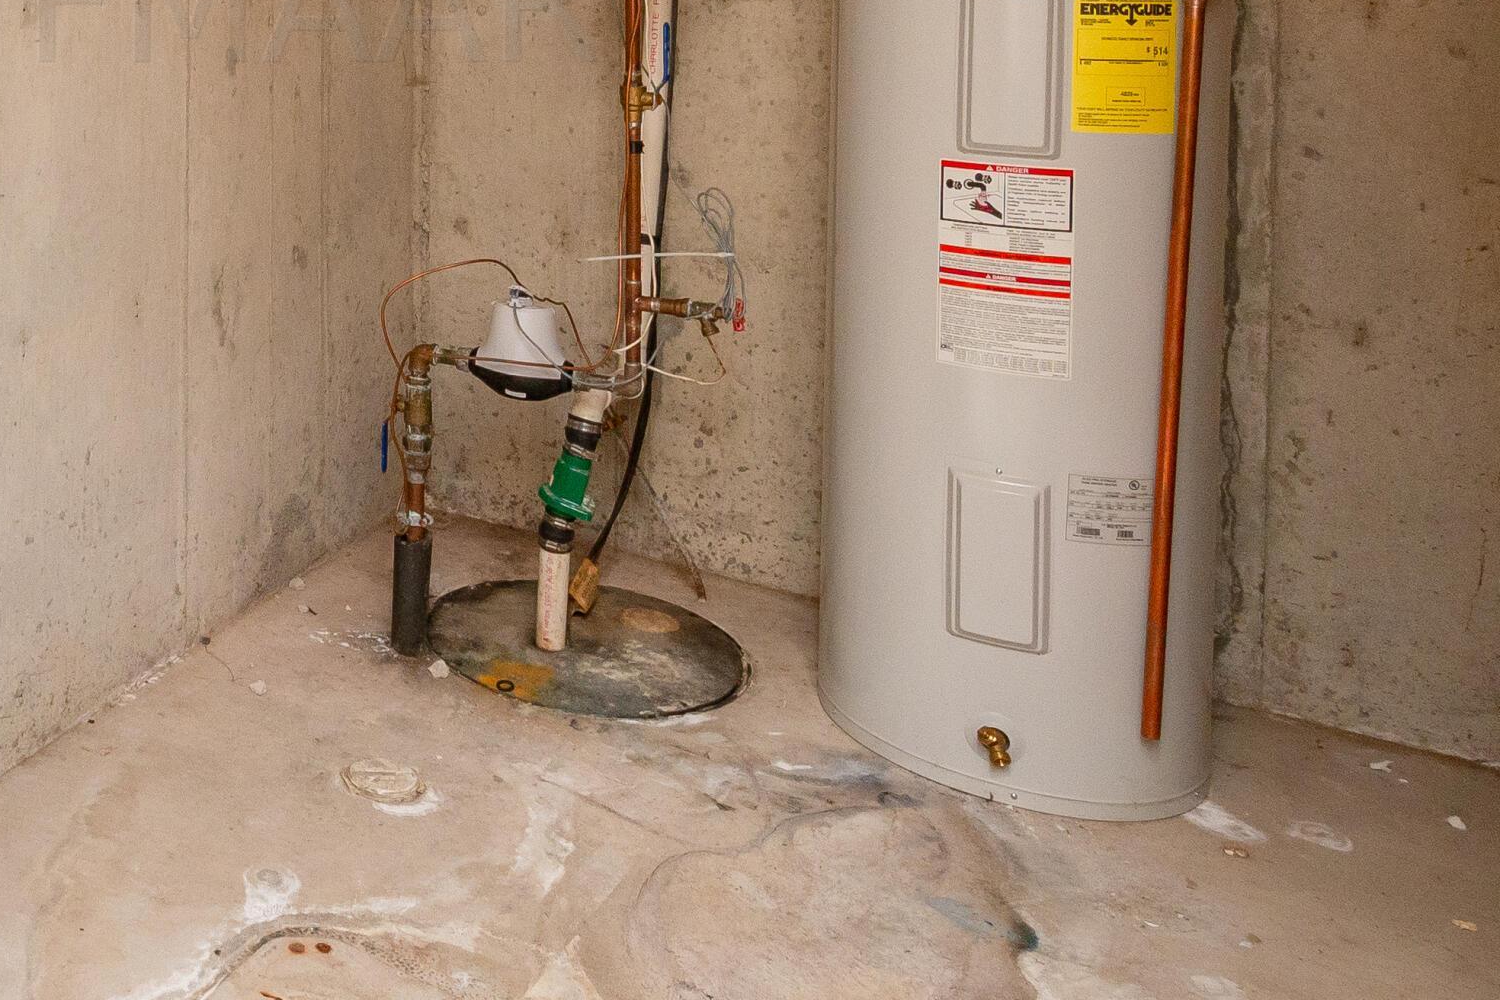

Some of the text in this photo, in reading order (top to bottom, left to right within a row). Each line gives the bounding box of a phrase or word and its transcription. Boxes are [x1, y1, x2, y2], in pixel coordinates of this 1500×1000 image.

[1080, 3, 1173, 19] ENERGYGUIDE
[649, 13, 660, 74] CHARLOTTE
[995, 166, 1030, 174] DANGER
